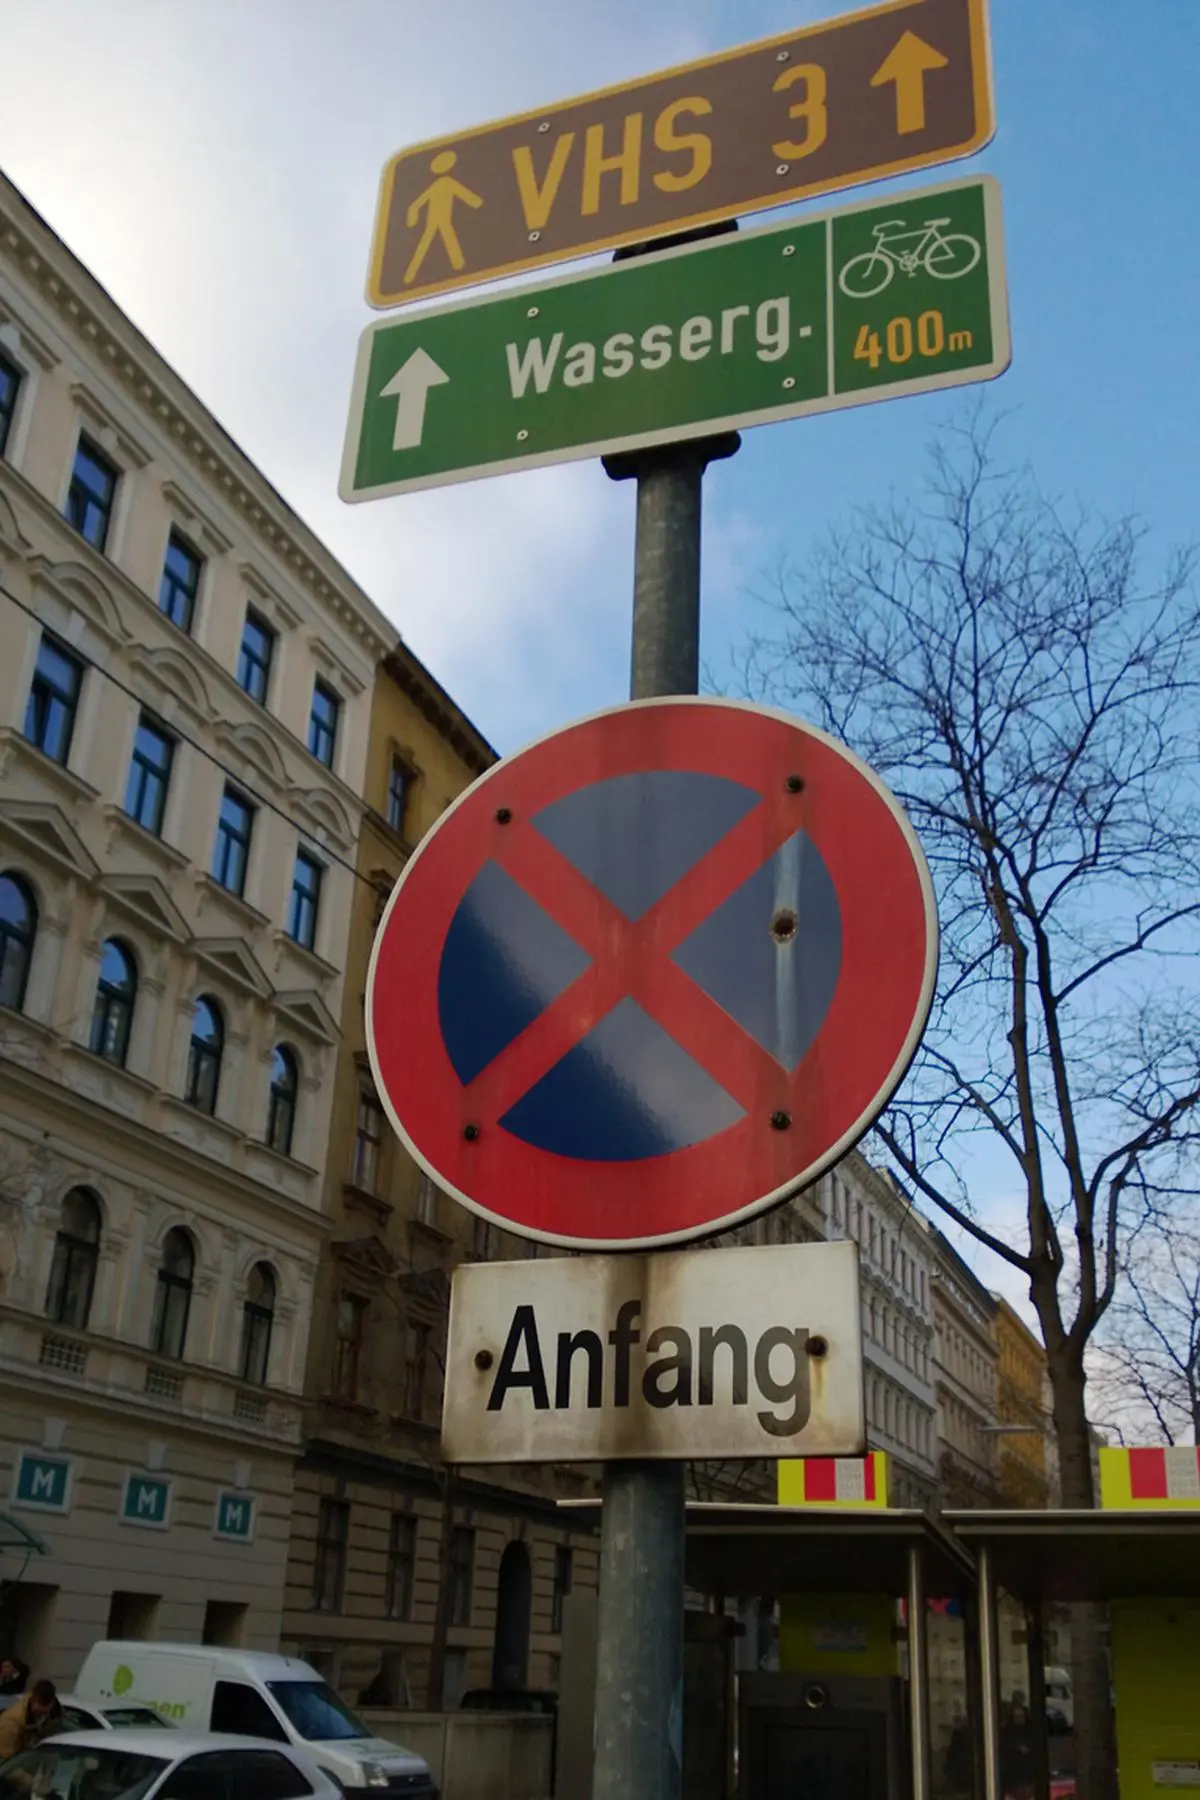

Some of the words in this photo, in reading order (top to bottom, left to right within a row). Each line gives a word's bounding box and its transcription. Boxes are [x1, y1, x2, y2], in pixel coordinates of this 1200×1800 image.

[512, 97, 712, 230] VHS
[773, 63, 827, 160] 3
[506, 296, 812, 398] Wasserg.
[487, 1300, 811, 1438] Anfang
[32, 1467, 55, 1498] M
[137, 1486, 156, 1515] M
[225, 1503, 243, 1531] M
